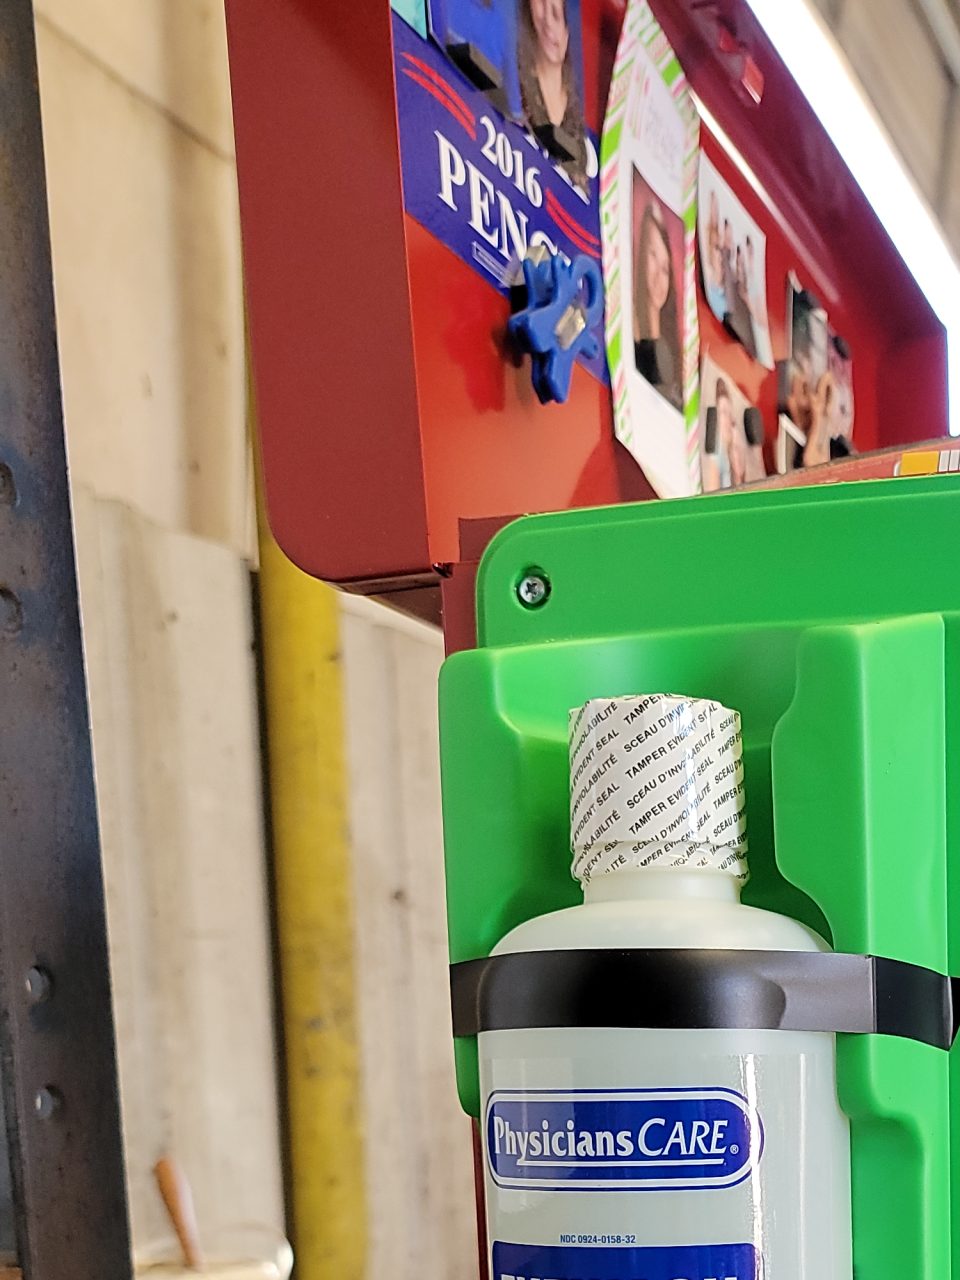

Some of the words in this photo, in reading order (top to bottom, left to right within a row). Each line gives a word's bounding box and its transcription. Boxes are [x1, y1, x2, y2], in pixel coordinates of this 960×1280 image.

[479, 115, 543, 208] 2016
[596, 729, 619, 751] SEAL
[624, 724, 658, 753] SCEAU
[625, 746, 667, 779] TAMPER
[596, 783, 620, 806] SEAL
[626, 779, 657, 809] SCEAU
[629, 802, 667, 835] TAMPER
[560, 1234, 577, 1244] NDC
[577, 1234, 636, 1244] 0924-0158-32
